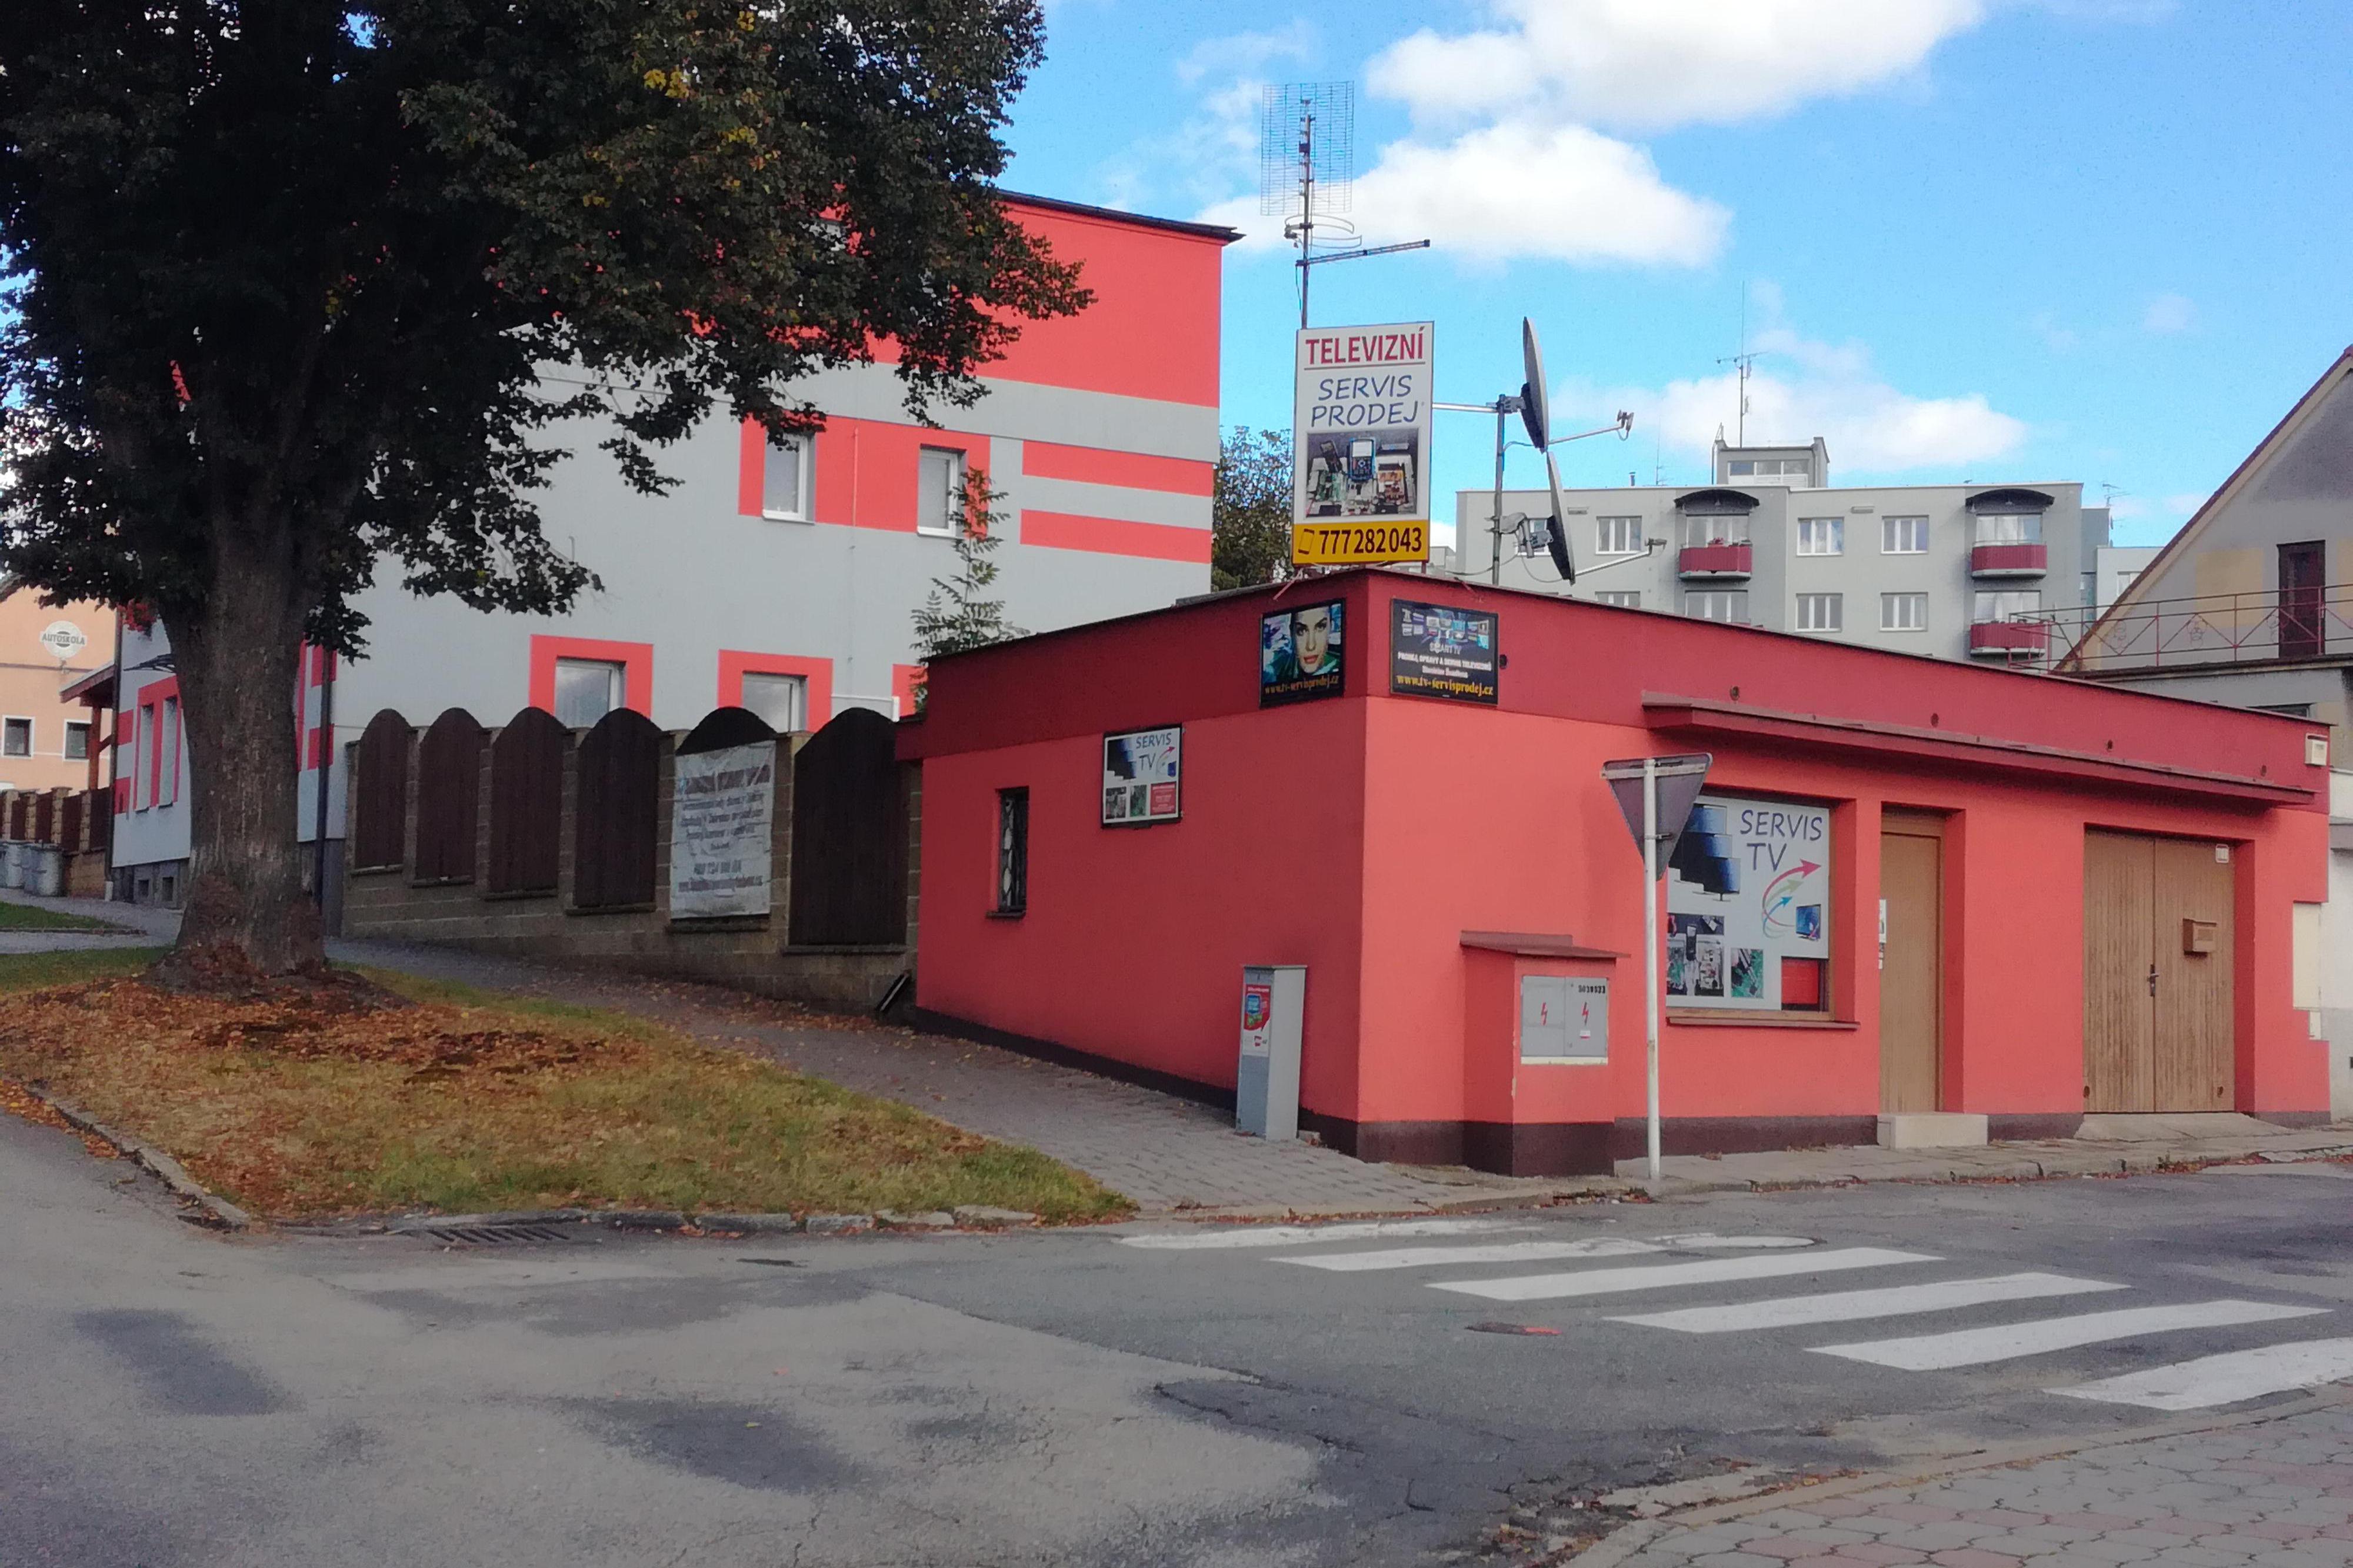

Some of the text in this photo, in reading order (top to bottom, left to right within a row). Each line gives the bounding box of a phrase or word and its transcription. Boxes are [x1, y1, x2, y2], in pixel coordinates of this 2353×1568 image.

[1305, 326, 1425, 365] TELEVIZNÍ
[1318, 375, 1412, 401] SERVIS
[1311, 401, 1418, 428] PRODEJ
[1136, 732, 1172, 749] SERVIS
[1139, 753, 1156, 771] TV
[1739, 809, 1822, 842] SERVIS
[1747, 842, 1787, 872] TV
